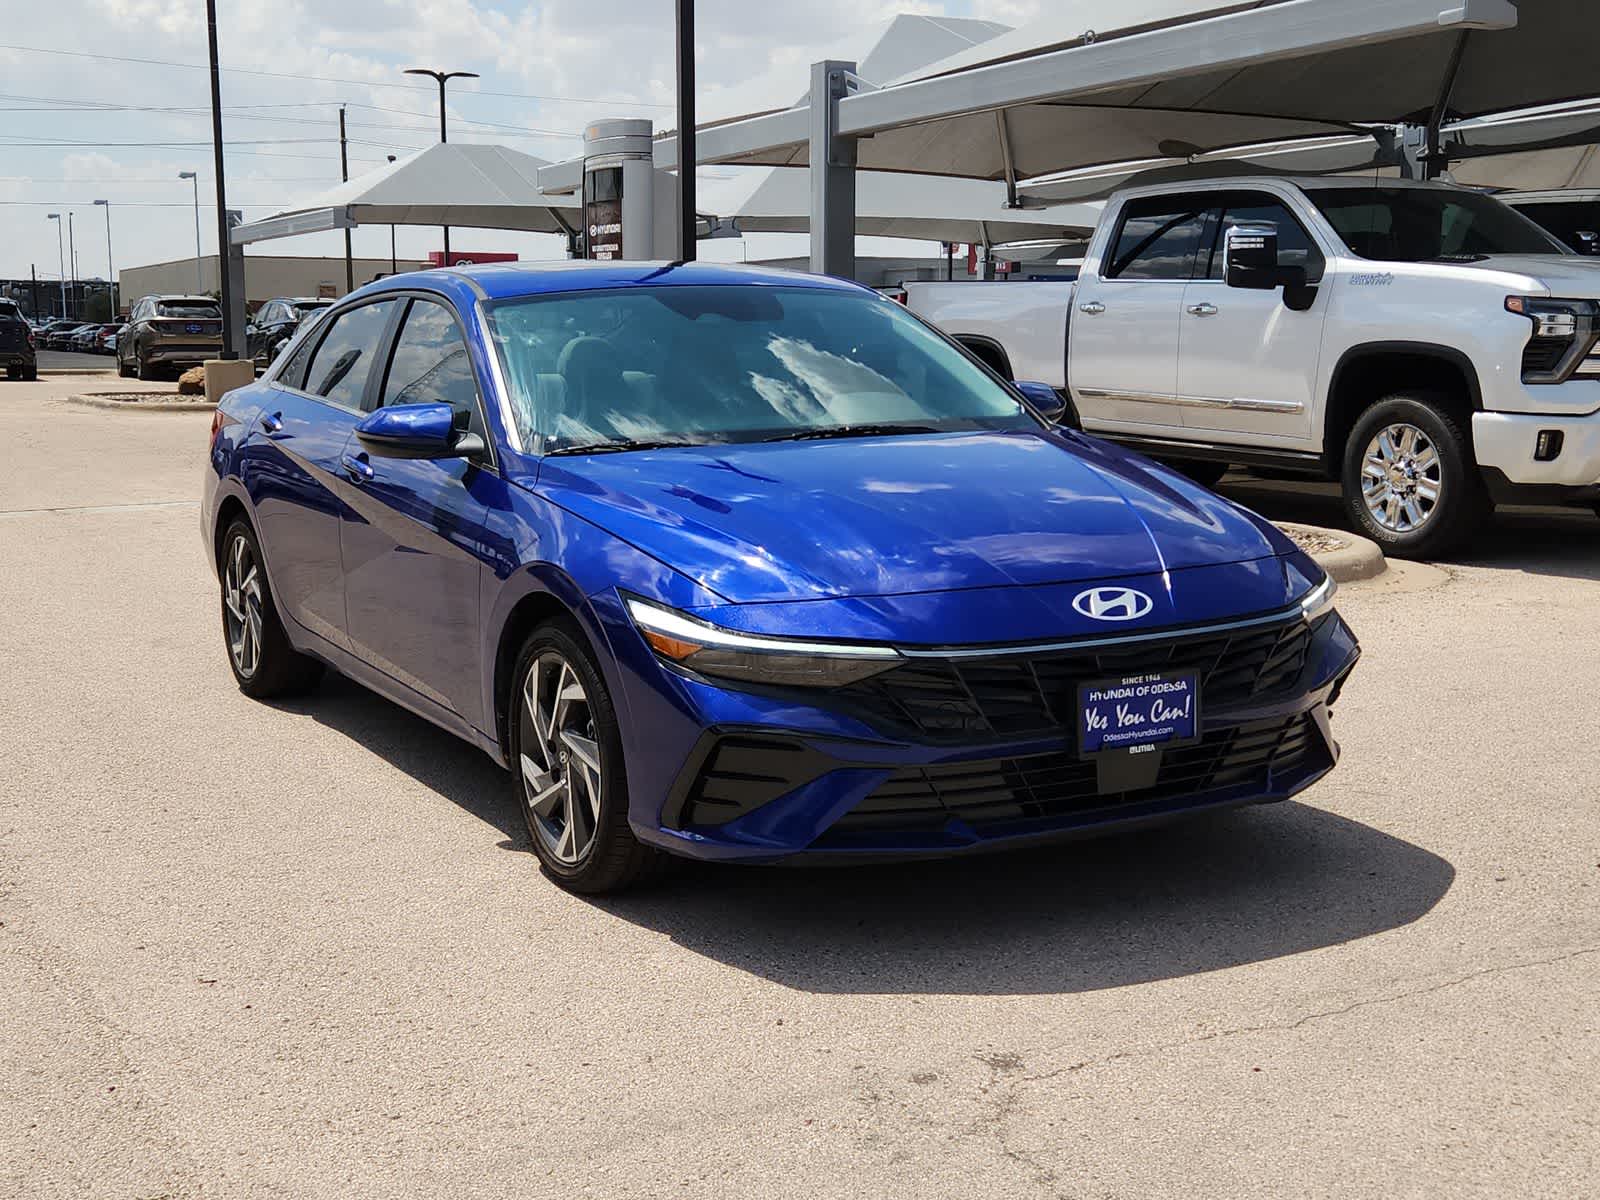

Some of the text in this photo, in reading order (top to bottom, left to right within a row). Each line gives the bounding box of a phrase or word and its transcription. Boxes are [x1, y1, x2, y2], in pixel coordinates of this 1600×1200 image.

[1121, 676, 1144, 686] SINCE
[1089, 681, 1188, 702] HYUNDAI OF ODESSA
[1085, 695, 1191, 732] Yes You Can!
[1103, 726, 1174, 742] OdessaHyundai.com
